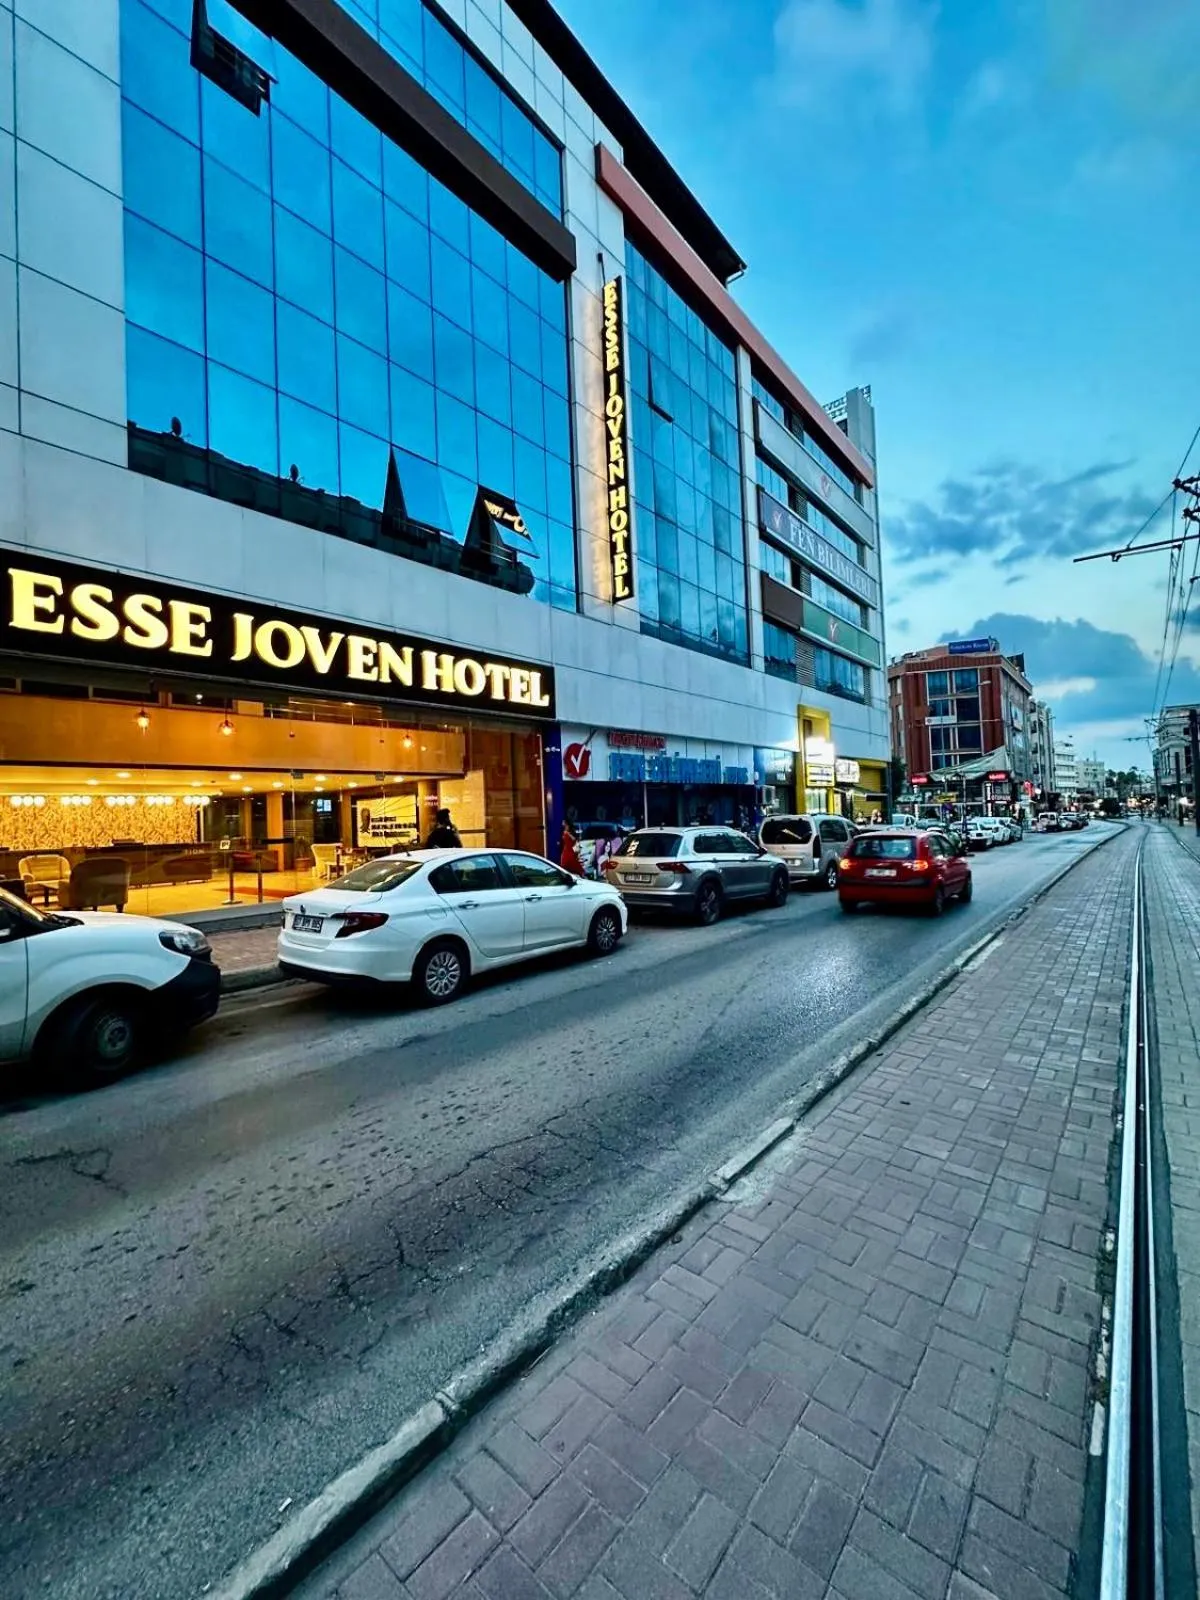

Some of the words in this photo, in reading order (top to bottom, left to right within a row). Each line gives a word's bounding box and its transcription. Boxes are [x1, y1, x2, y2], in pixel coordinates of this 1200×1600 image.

[603, 281, 619, 372] ESSE
[605, 372, 626, 485] JOVEN
[610, 486, 630, 599] HOTEL
[790, 522, 817, 558] FEN
[7, 567, 214, 658] ESSE
[230, 612, 414, 687] JOVEN
[421, 649, 551, 708] HOTEL
